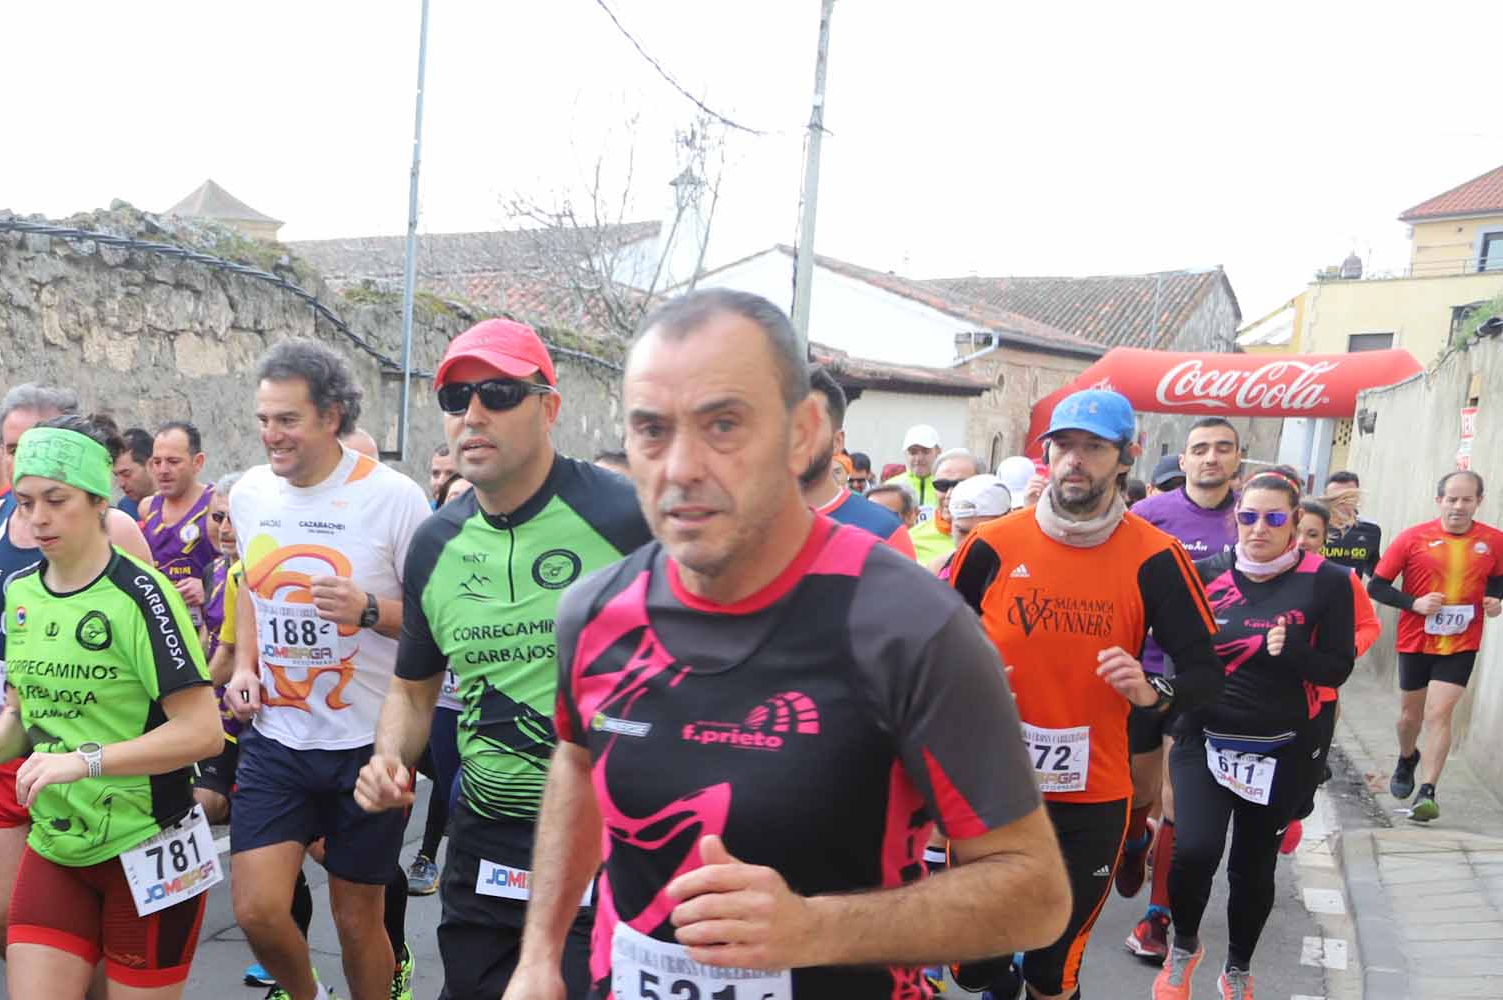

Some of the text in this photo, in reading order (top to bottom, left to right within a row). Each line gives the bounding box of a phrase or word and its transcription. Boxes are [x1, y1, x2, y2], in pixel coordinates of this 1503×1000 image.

[1156, 360, 1339, 409] Coca-Cola
[1351, 548, 1367, 557] GO
[134, 576, 186, 670] CARBAJOSA
[268, 617, 317, 646] 188
[1435, 613, 1465, 626] 670
[464, 644, 556, 665] CARBAJOS
[680, 723, 785, 748] f.prieto
[1025, 741, 1072, 771] 72
[1218, 755, 1256, 785] 611
[145, 832, 200, 880] 781
